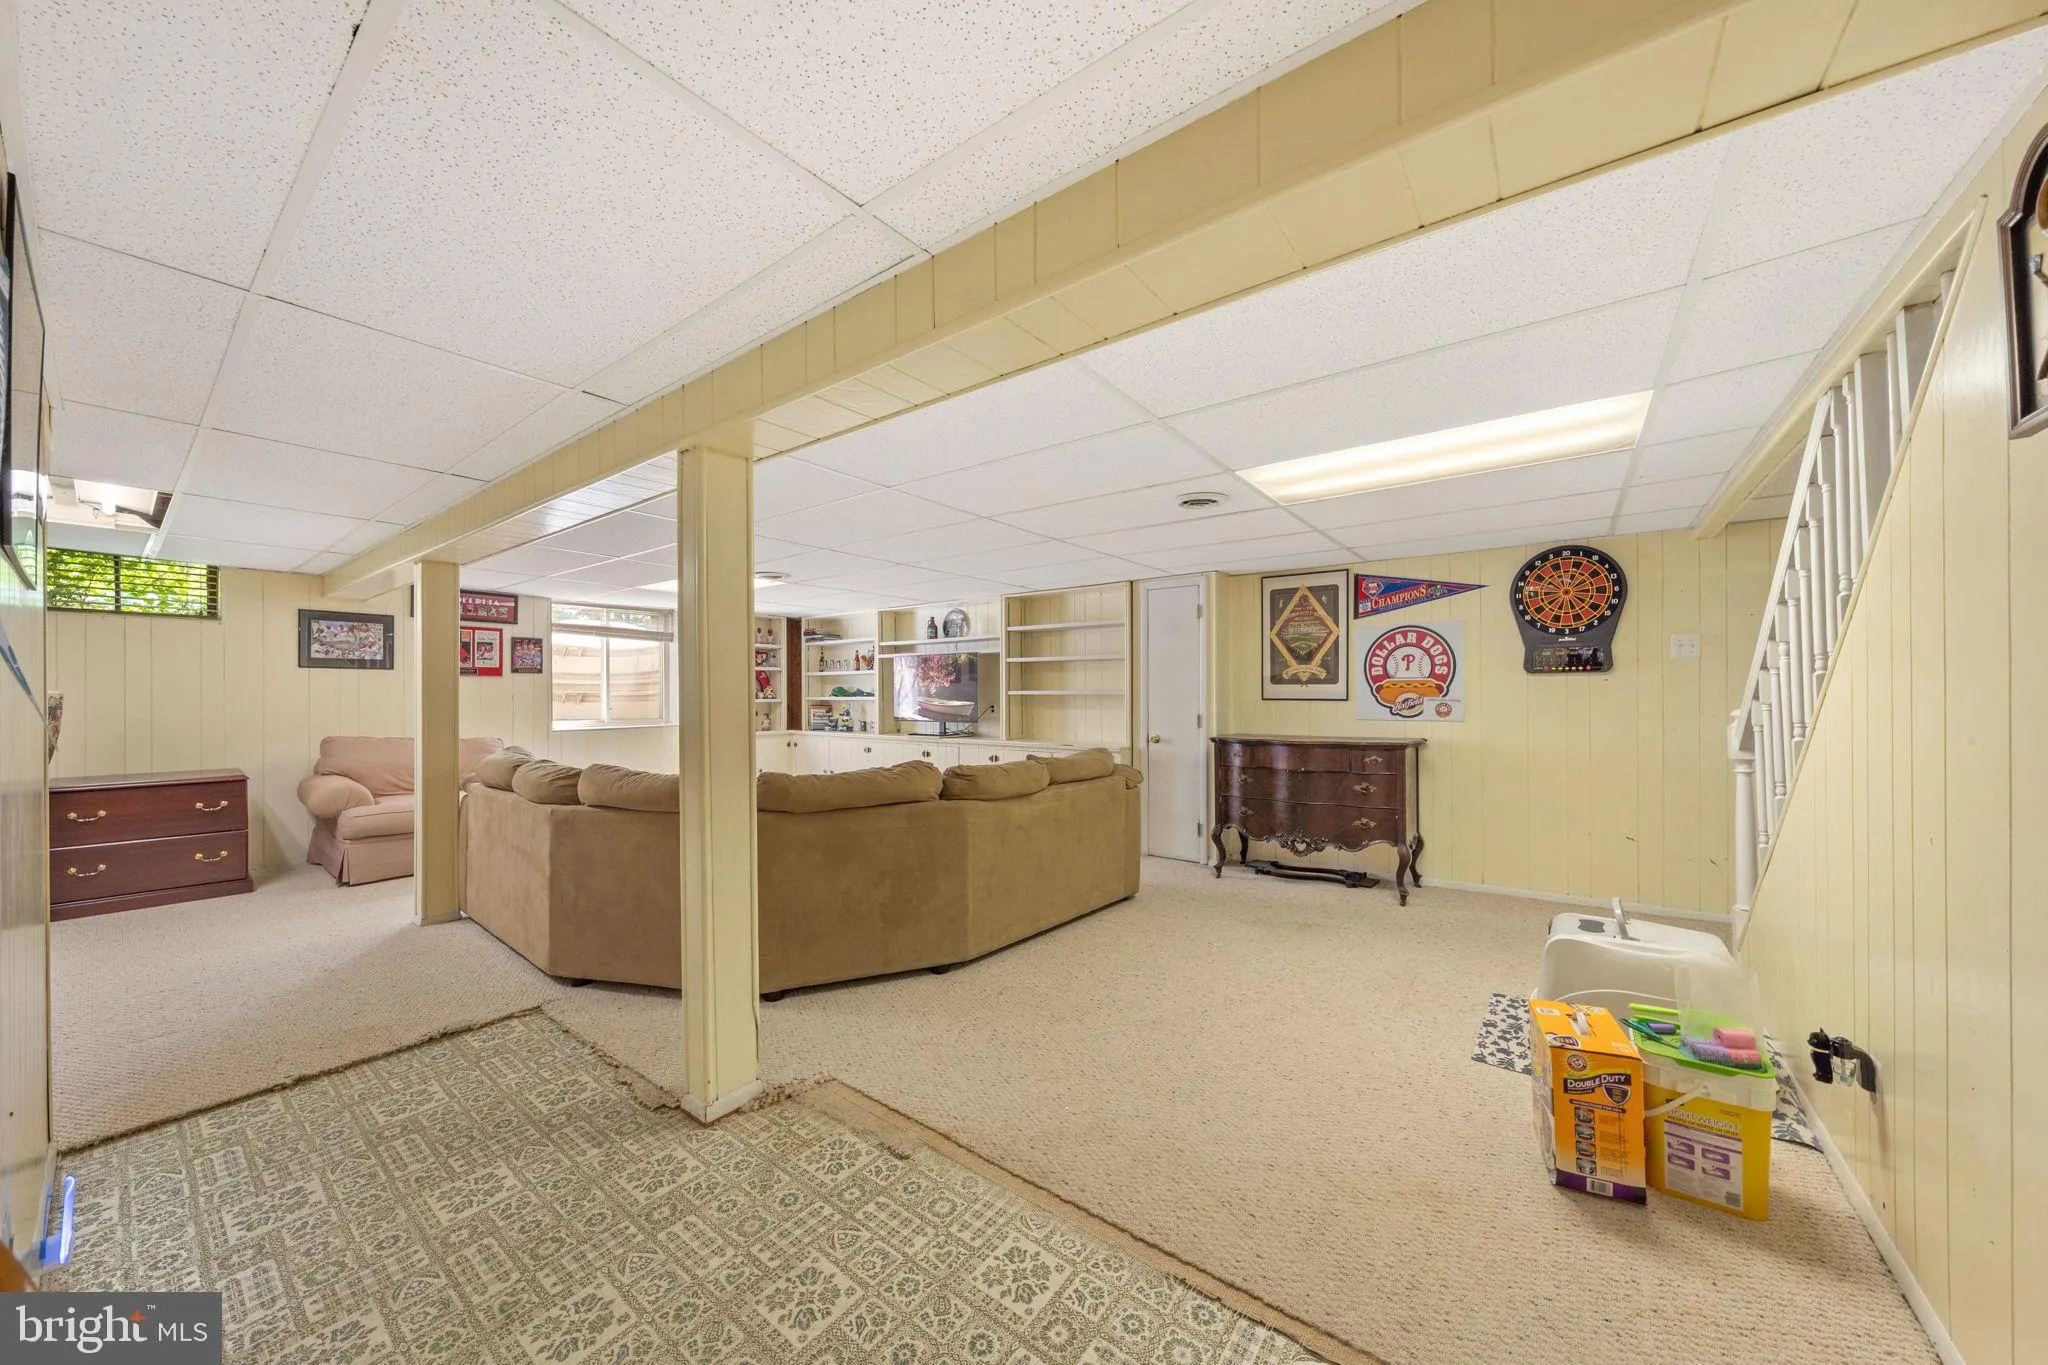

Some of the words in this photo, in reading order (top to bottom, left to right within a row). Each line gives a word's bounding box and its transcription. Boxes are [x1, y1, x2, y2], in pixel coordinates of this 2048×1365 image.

[1372, 584, 1428, 608] CHAMPIONS
[1371, 632, 1417, 676] DOLLAR
[1421, 635, 1448, 675] DOGS
[1401, 654, 1415, 671] P
[1567, 1077, 1600, 1088] DOUBLE
[1601, 1075, 1626, 1083] DUTY
